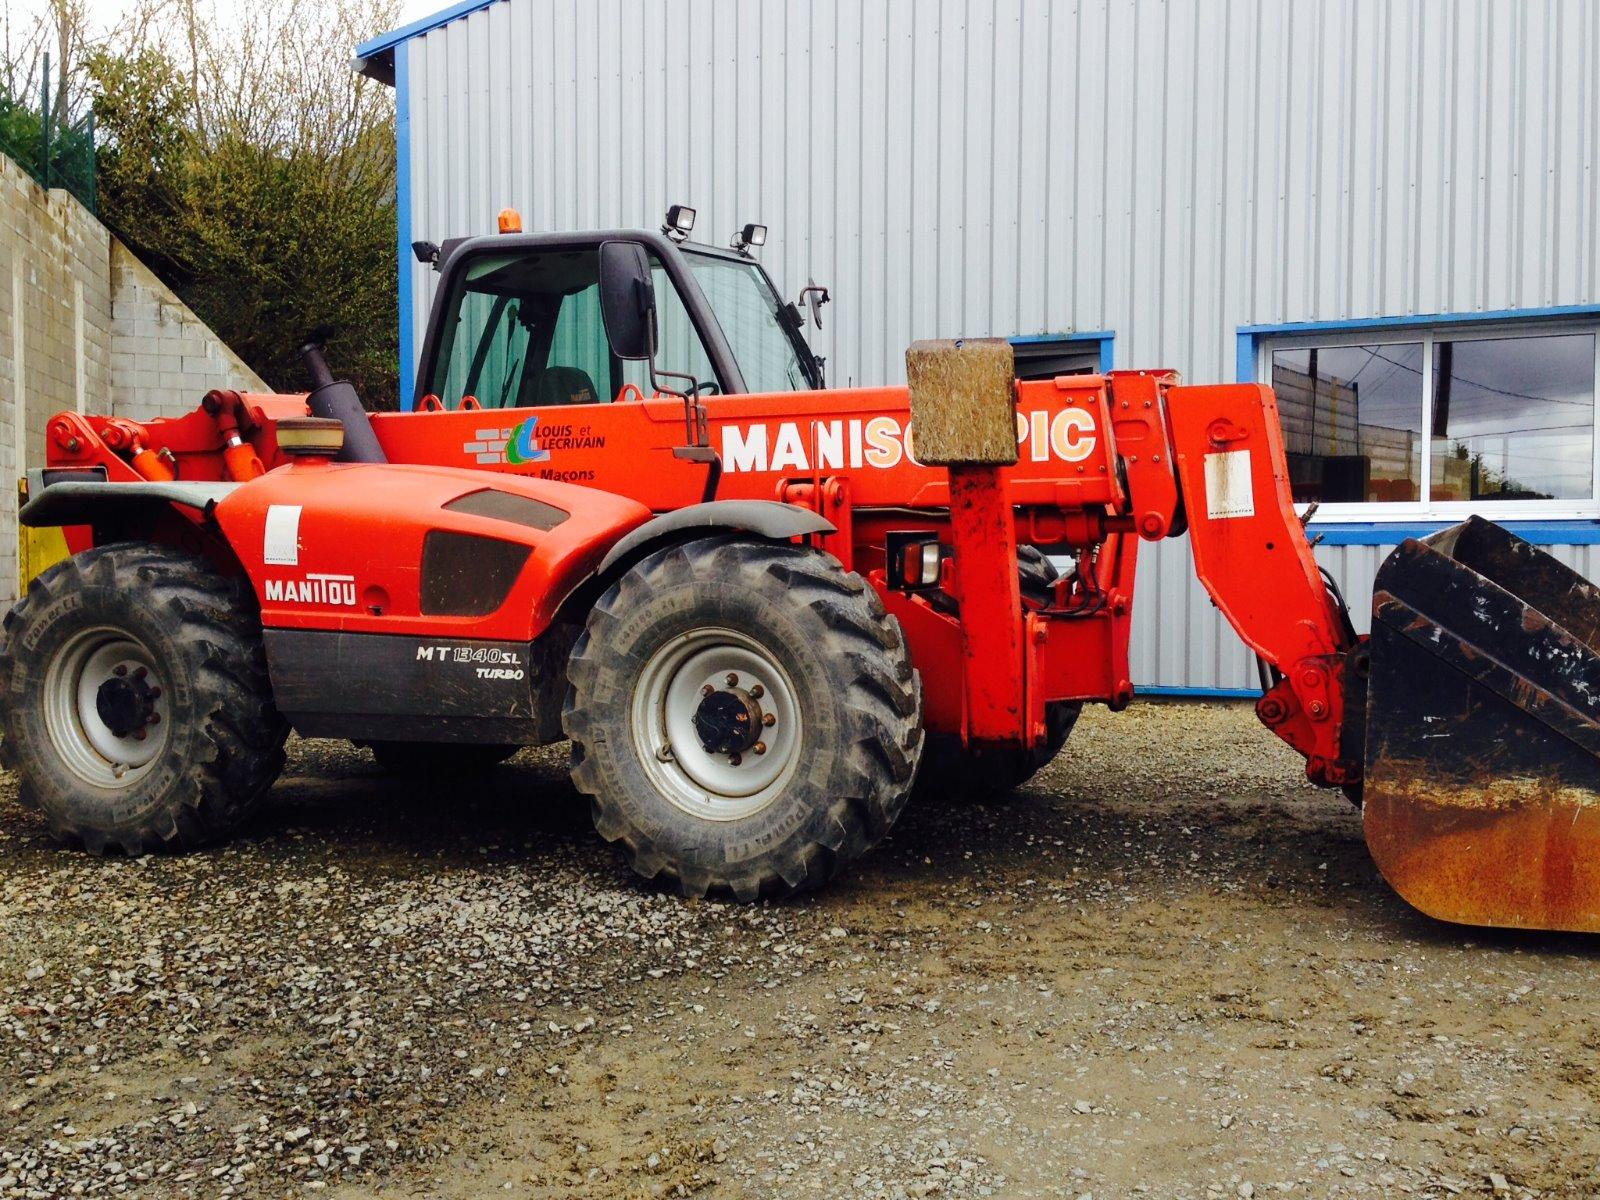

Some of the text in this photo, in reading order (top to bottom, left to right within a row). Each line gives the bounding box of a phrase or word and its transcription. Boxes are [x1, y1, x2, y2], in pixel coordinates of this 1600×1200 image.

[535, 425, 591, 438] LOUIS et
[541, 437, 605, 450] LECRIVAIN
[721, 408, 1096, 473] MANISIC
[540, 469, 595, 482] Maçons
[265, 573, 356, 605] MANITOU
[416, 646, 451, 661] MT
[476, 668, 524, 680] TURBO
